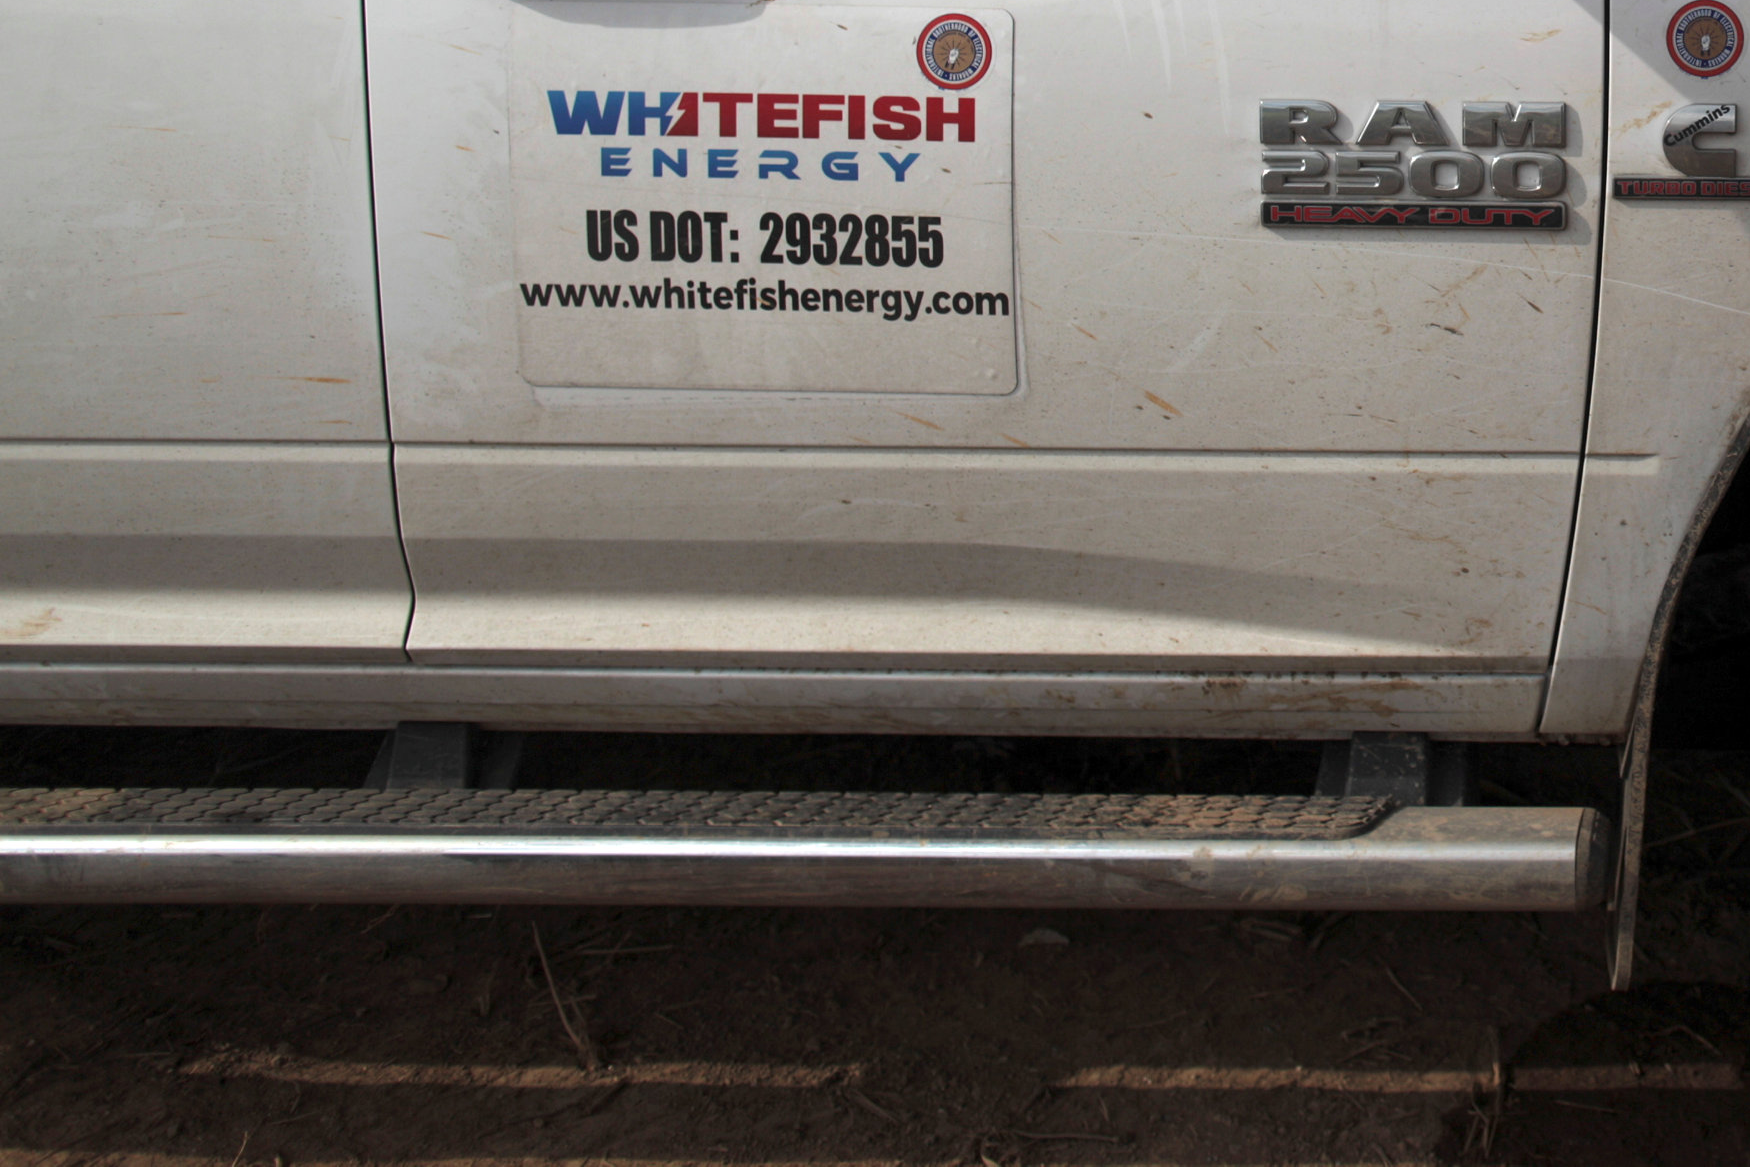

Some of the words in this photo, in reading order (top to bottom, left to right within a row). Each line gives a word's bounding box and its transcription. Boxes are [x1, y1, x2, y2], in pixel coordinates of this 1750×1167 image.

[547, 90, 976, 143] WHITEFISH
[1259, 98, 1567, 147] RAM
[1663, 104, 1730, 146] Cummins
[600, 146, 921, 182] ENERGY
[1261, 149, 1567, 198] 2500
[1620, 180, 1697, 196] TURBO
[1271, 205, 1420, 224] HEAVY
[1429, 206, 1555, 225] DUTY
[585, 209, 640, 262] US
[650, 210, 739, 263] DOT:
[759, 212, 945, 268] 2932855
[520, 277, 1010, 321] www.whitefishenergy.com
